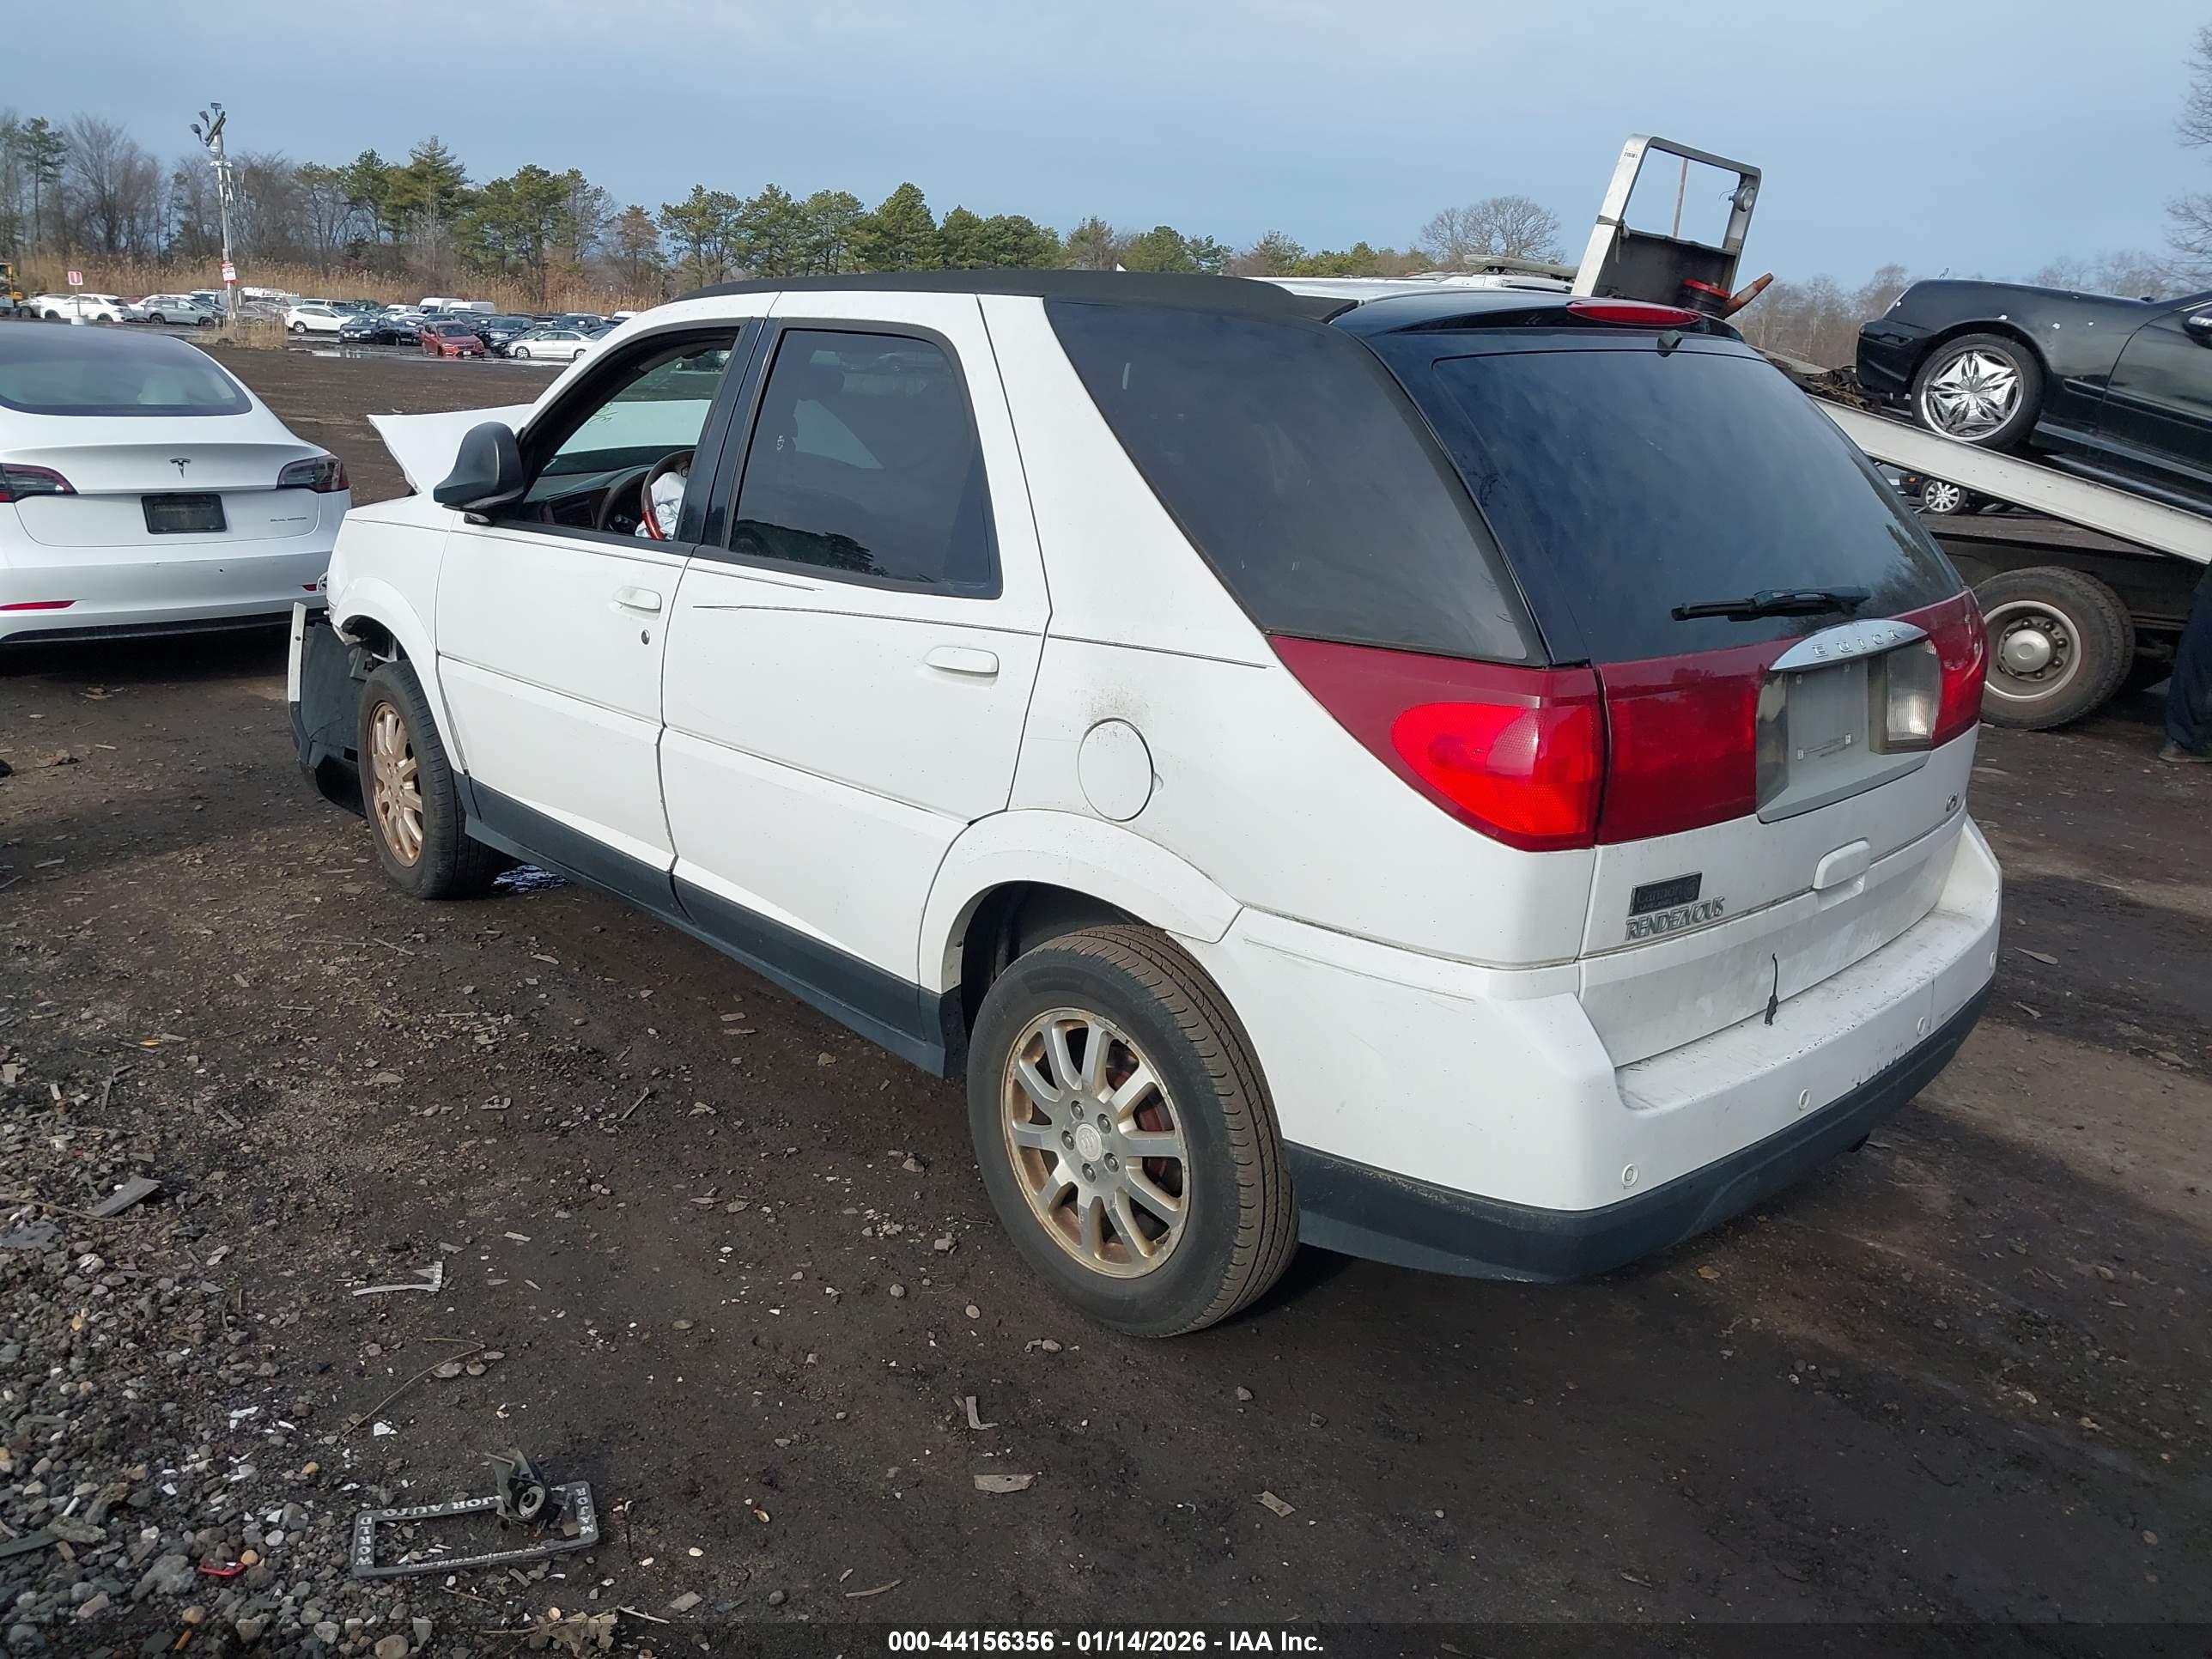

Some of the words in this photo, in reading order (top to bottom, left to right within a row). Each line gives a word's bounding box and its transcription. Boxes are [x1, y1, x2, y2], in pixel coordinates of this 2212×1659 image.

[381, 1504, 445, 1516] AUTO
[575, 1487, 595, 1534] MAJOR
[356, 1516, 373, 1565] WORLD
